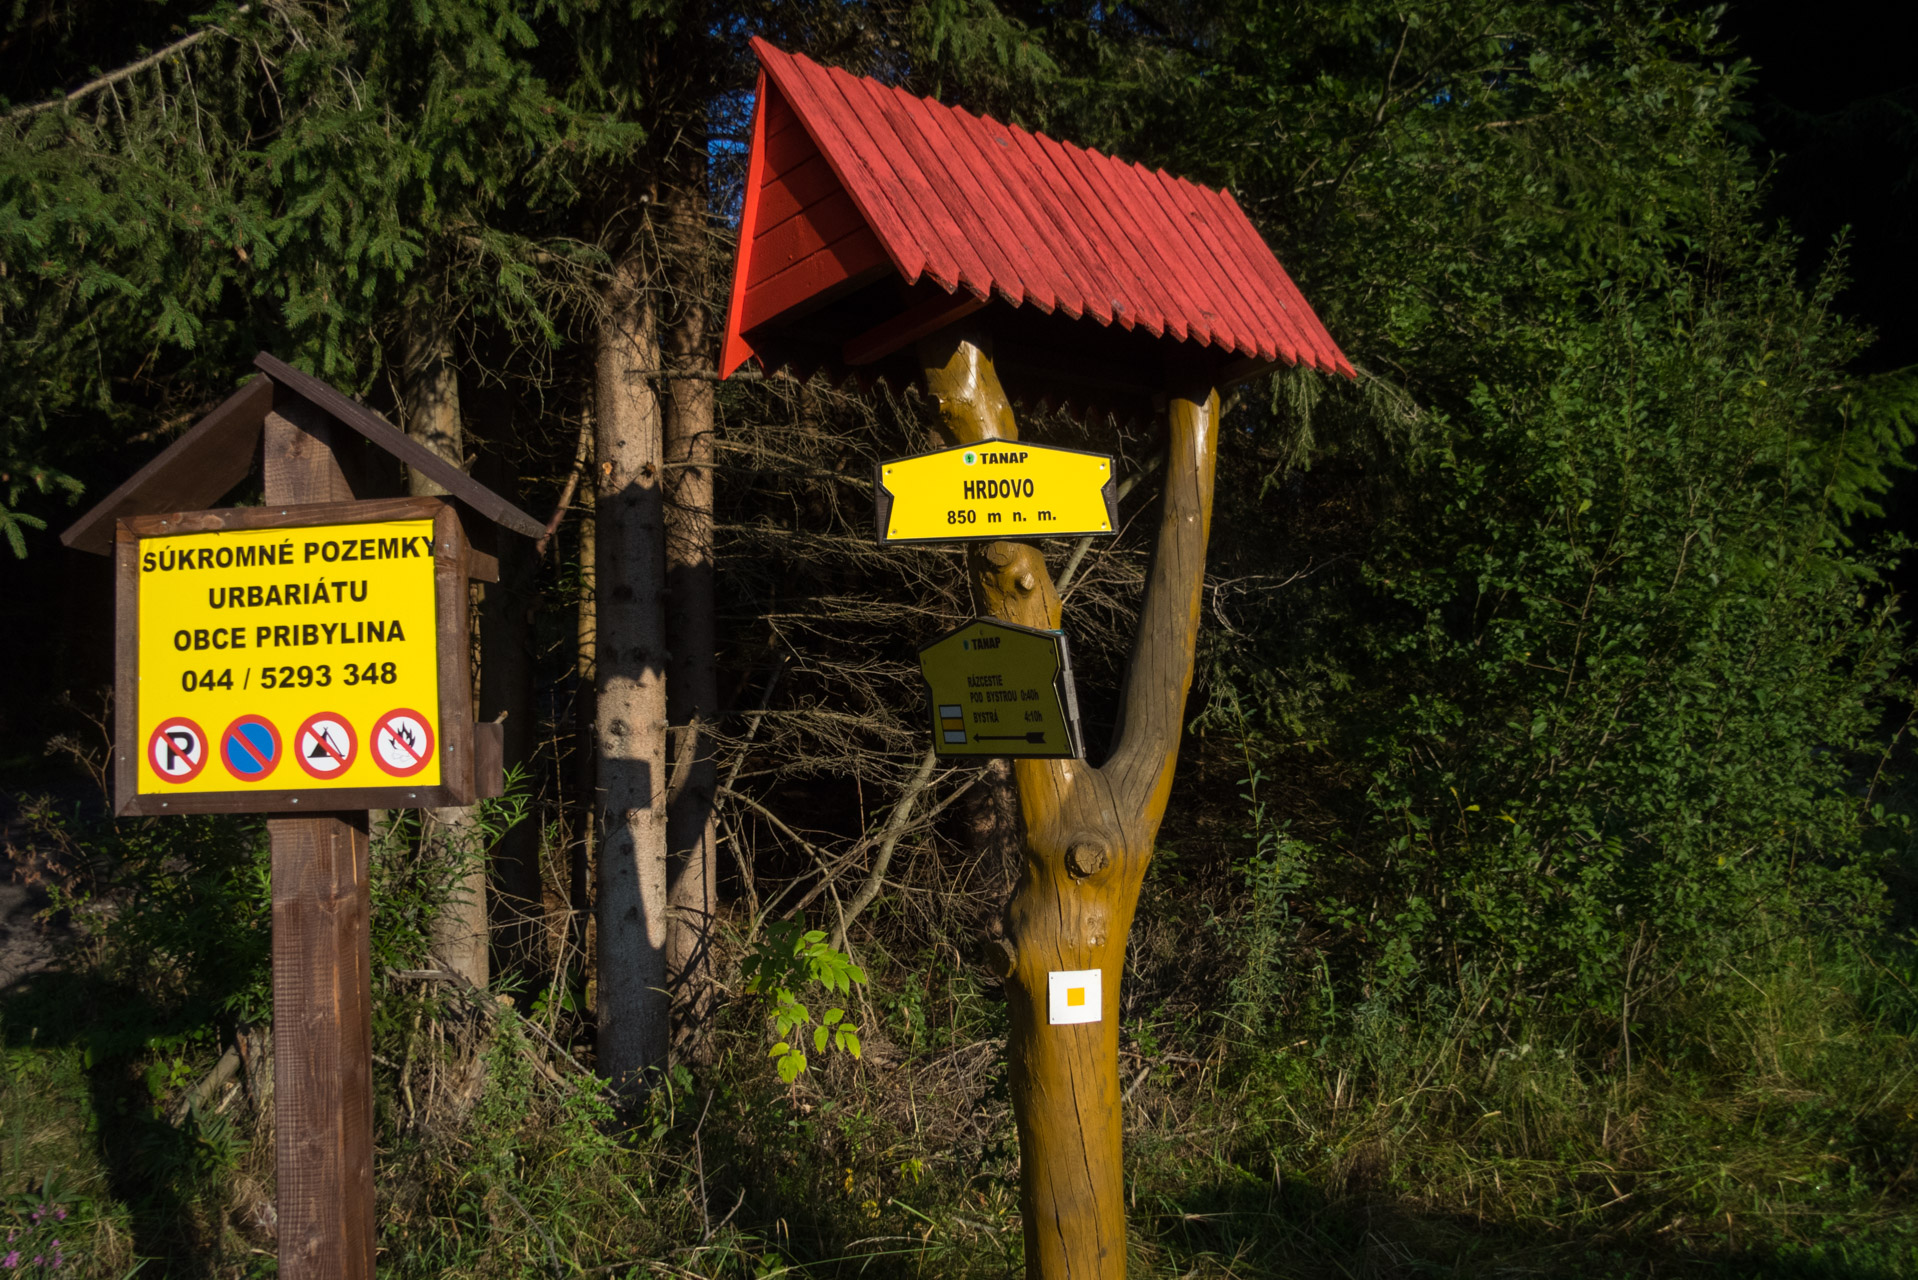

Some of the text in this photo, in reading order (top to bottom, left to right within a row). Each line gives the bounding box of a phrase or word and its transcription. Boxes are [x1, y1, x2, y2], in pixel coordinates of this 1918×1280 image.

[980, 452, 1028, 465] TANAP
[964, 478, 1034, 499] HRDOVO
[947, 509, 1057, 525] 850 m n. m.
[142, 536, 436, 572] SÚKROMNÉ POZEMKY
[208, 577, 368, 609] URBARIÁTU
[174, 620, 405, 651] OBCE PRIBYLINA
[971, 637, 1001, 651] TANAP
[181, 662, 397, 692] 044 / 5293 348
[967, 674, 1003, 688] RÁZCESTIE
[970, 691, 983, 703] POD
[987, 689, 1017, 703] BYSTROU
[973, 707, 999, 724] BYSTRÁ
